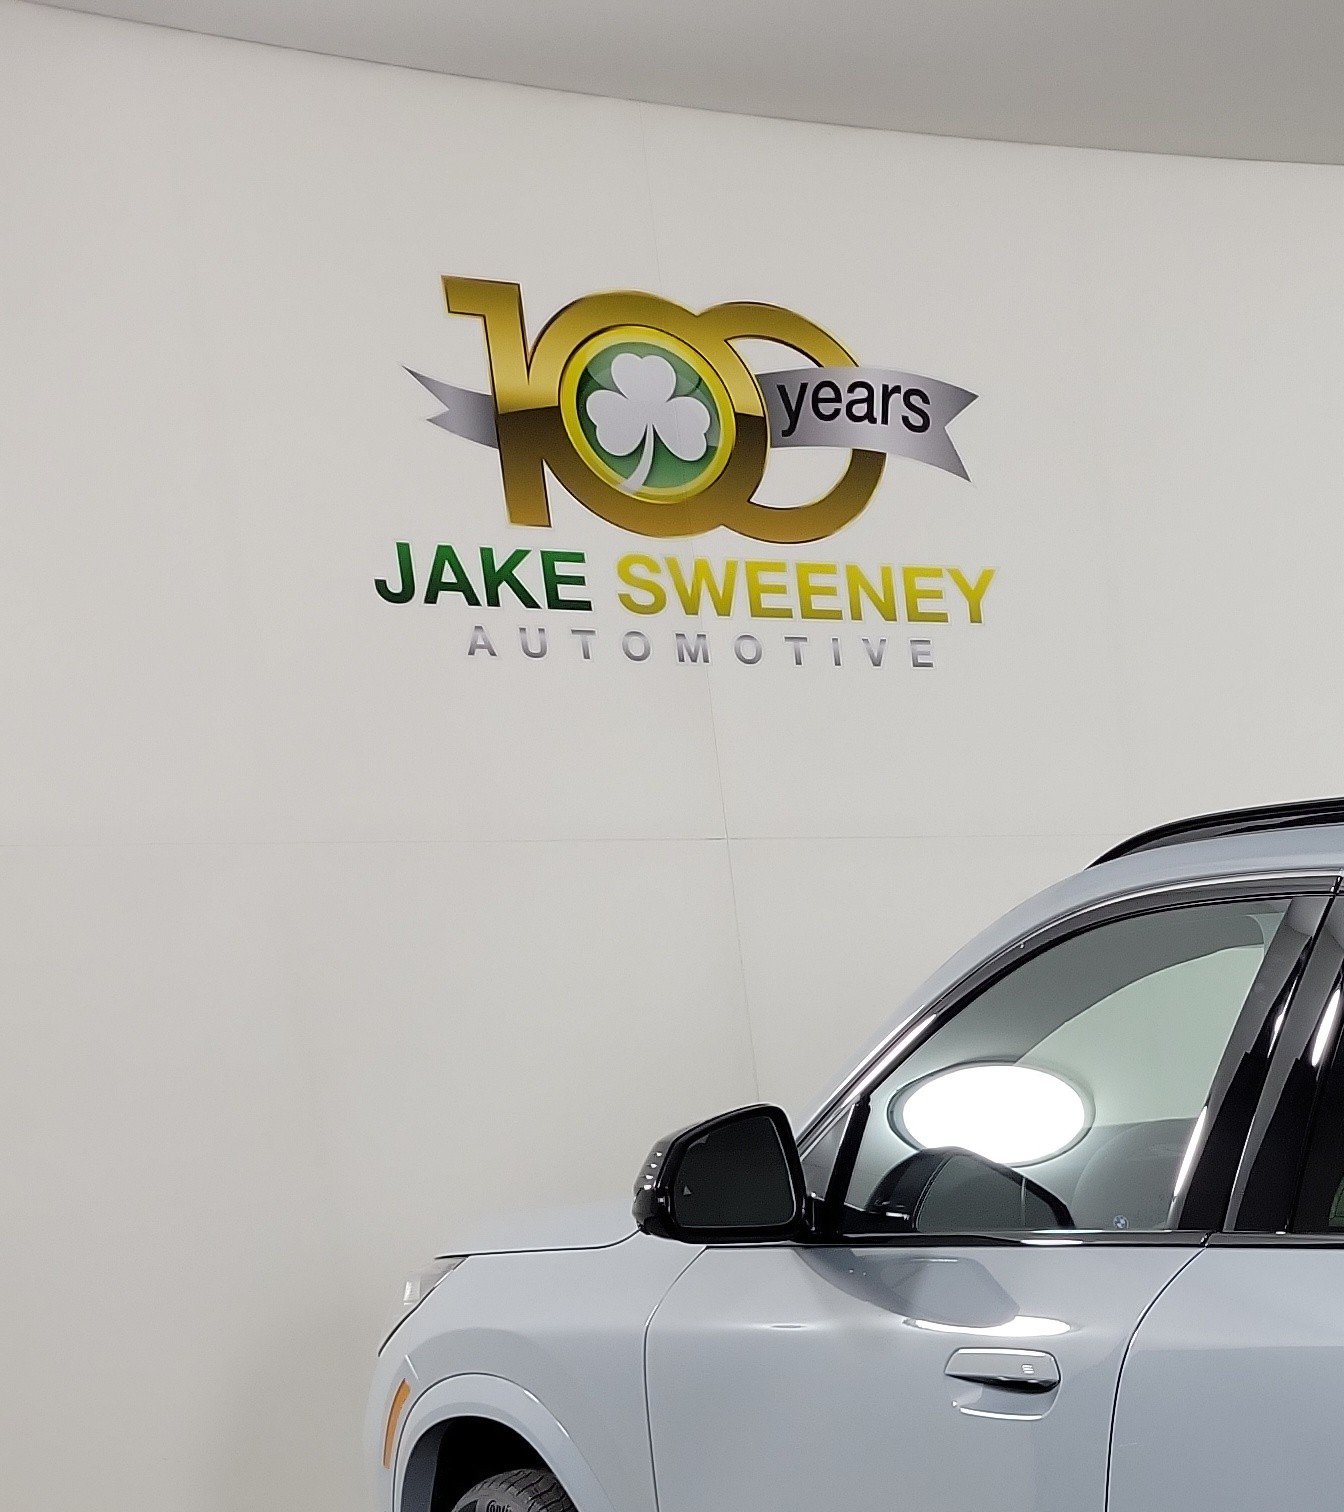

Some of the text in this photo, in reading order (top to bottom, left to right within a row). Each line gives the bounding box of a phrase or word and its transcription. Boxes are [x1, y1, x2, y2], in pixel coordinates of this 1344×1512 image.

[776, 377, 932, 437] years
[374, 541, 997, 624] JAKE SWEENEY
[467, 625, 935, 669] AUTOMOTIVE
